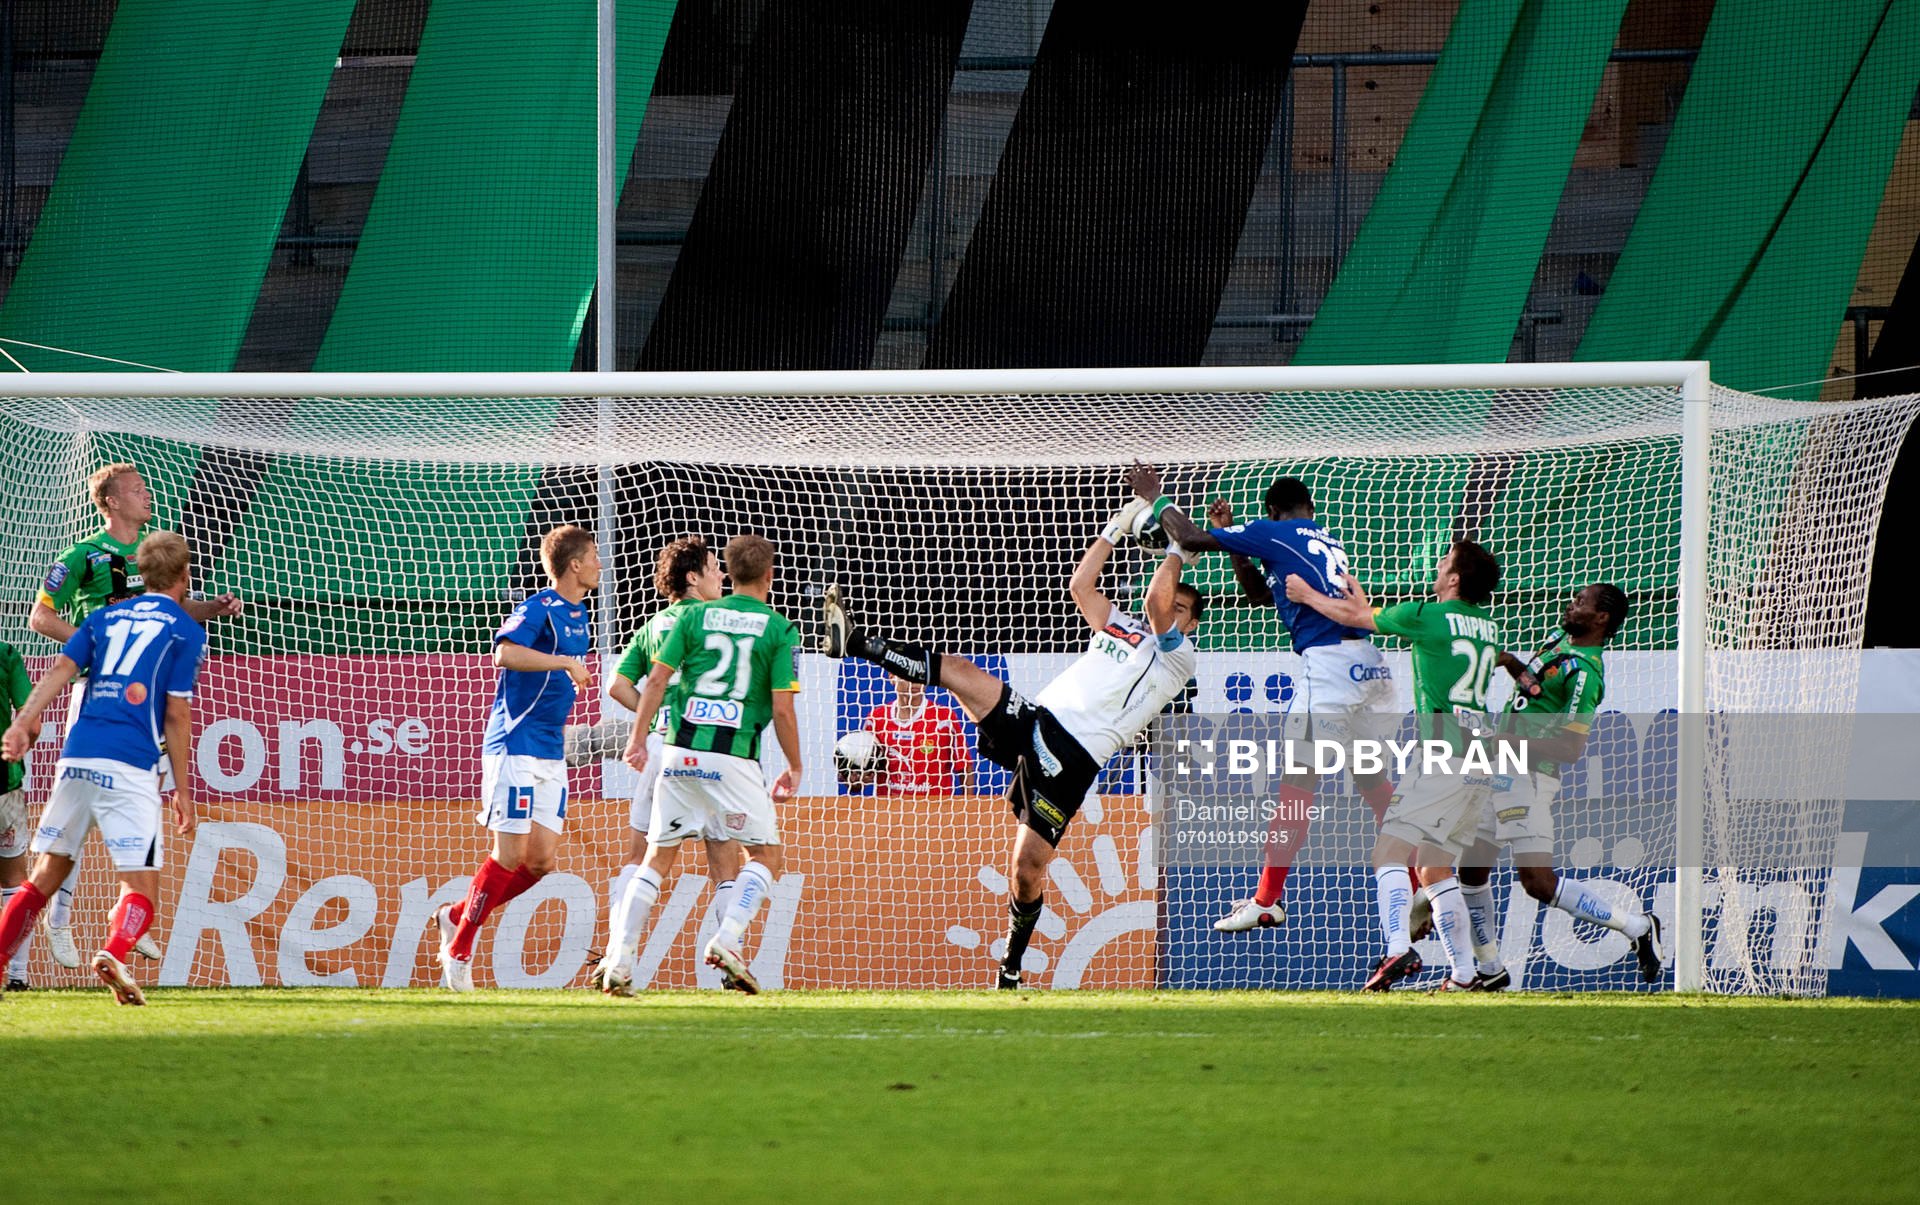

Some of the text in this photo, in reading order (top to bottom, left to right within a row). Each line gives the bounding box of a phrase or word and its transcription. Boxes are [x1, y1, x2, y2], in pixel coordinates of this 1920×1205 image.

[101, 617, 166, 677] 17
[694, 632, 756, 700] 21
[1448, 637, 1497, 709] 20
[692, 700, 739, 721] BDO
[158, 822, 804, 989] Renova
